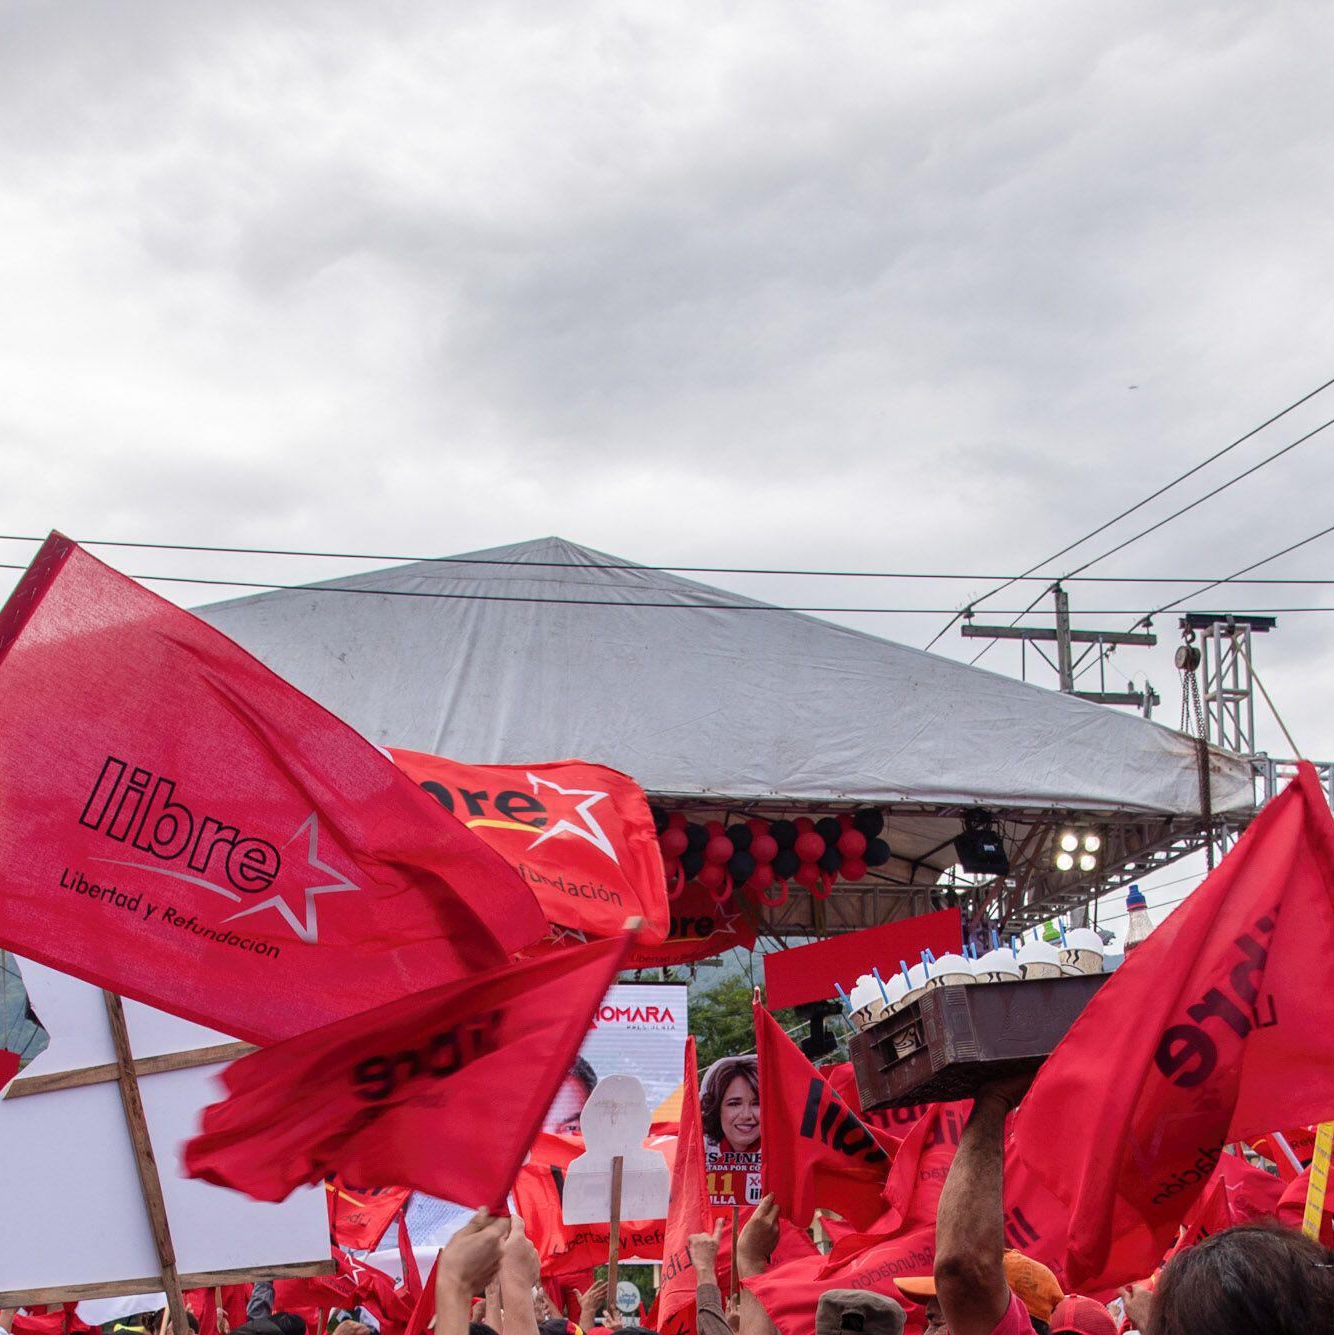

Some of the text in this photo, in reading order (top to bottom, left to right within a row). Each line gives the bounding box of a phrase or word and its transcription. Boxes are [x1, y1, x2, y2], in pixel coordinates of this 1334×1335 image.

[79, 756, 281, 894] libre
[60, 868, 143, 912] Libertad
[143, 902, 158, 920] y
